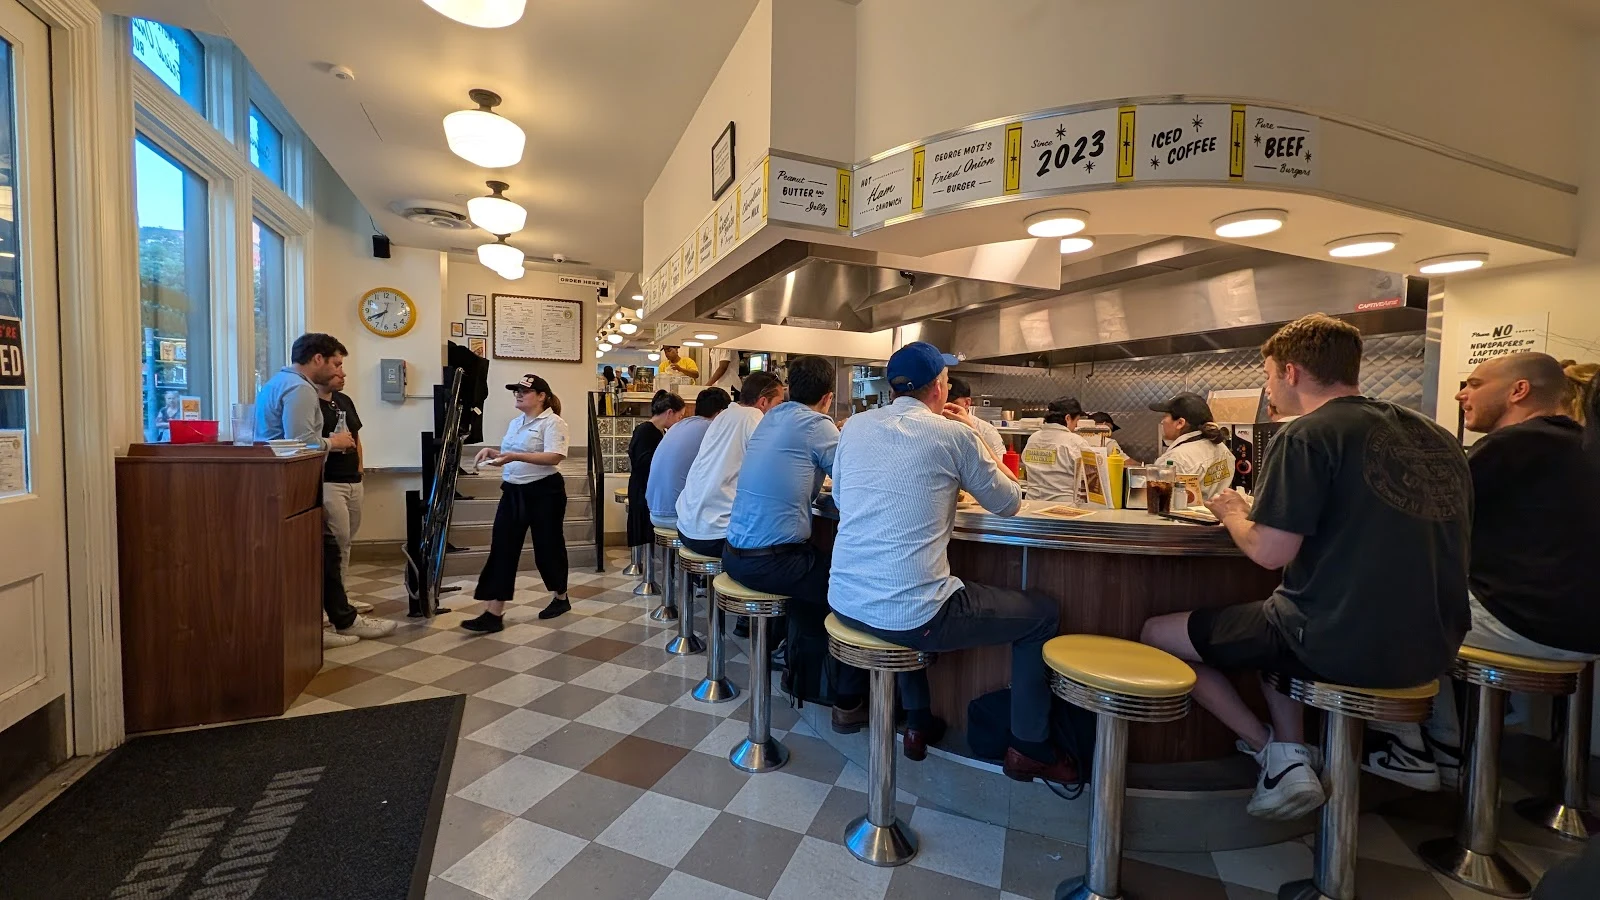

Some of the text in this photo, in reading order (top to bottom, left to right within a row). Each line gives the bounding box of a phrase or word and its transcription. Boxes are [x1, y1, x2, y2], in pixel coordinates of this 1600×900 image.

[1255, 117, 1275, 130] Pure
[1031, 139, 1054, 149] Since
[1151, 127, 1183, 149] ICED
[934, 141, 993, 163] GEORGE MOTZ'S
[1036, 129, 1106, 178] 2023
[1167, 136, 1217, 165] COFFEE
[1264, 136, 1305, 159] BEEF
[777, 170, 806, 184] Peanut
[931, 156, 996, 186] Fried Onion
[1279, 163, 1312, 179] Burgers
[860, 175, 873, 189] HOT
[946, 179, 977, 194] BURGER
[782, 186, 814, 198] BUTTER
[866, 182, 897, 206] Ham
[804, 200, 829, 217] Jelly
[875, 196, 903, 213] SANDWICH
[583, 279, 601, 287] HERE
[1492, 324, 1513, 338] NO
[1470, 339, 1524, 350] NEWSPAPERS
[1472, 348, 1509, 357] LAPTOPS
